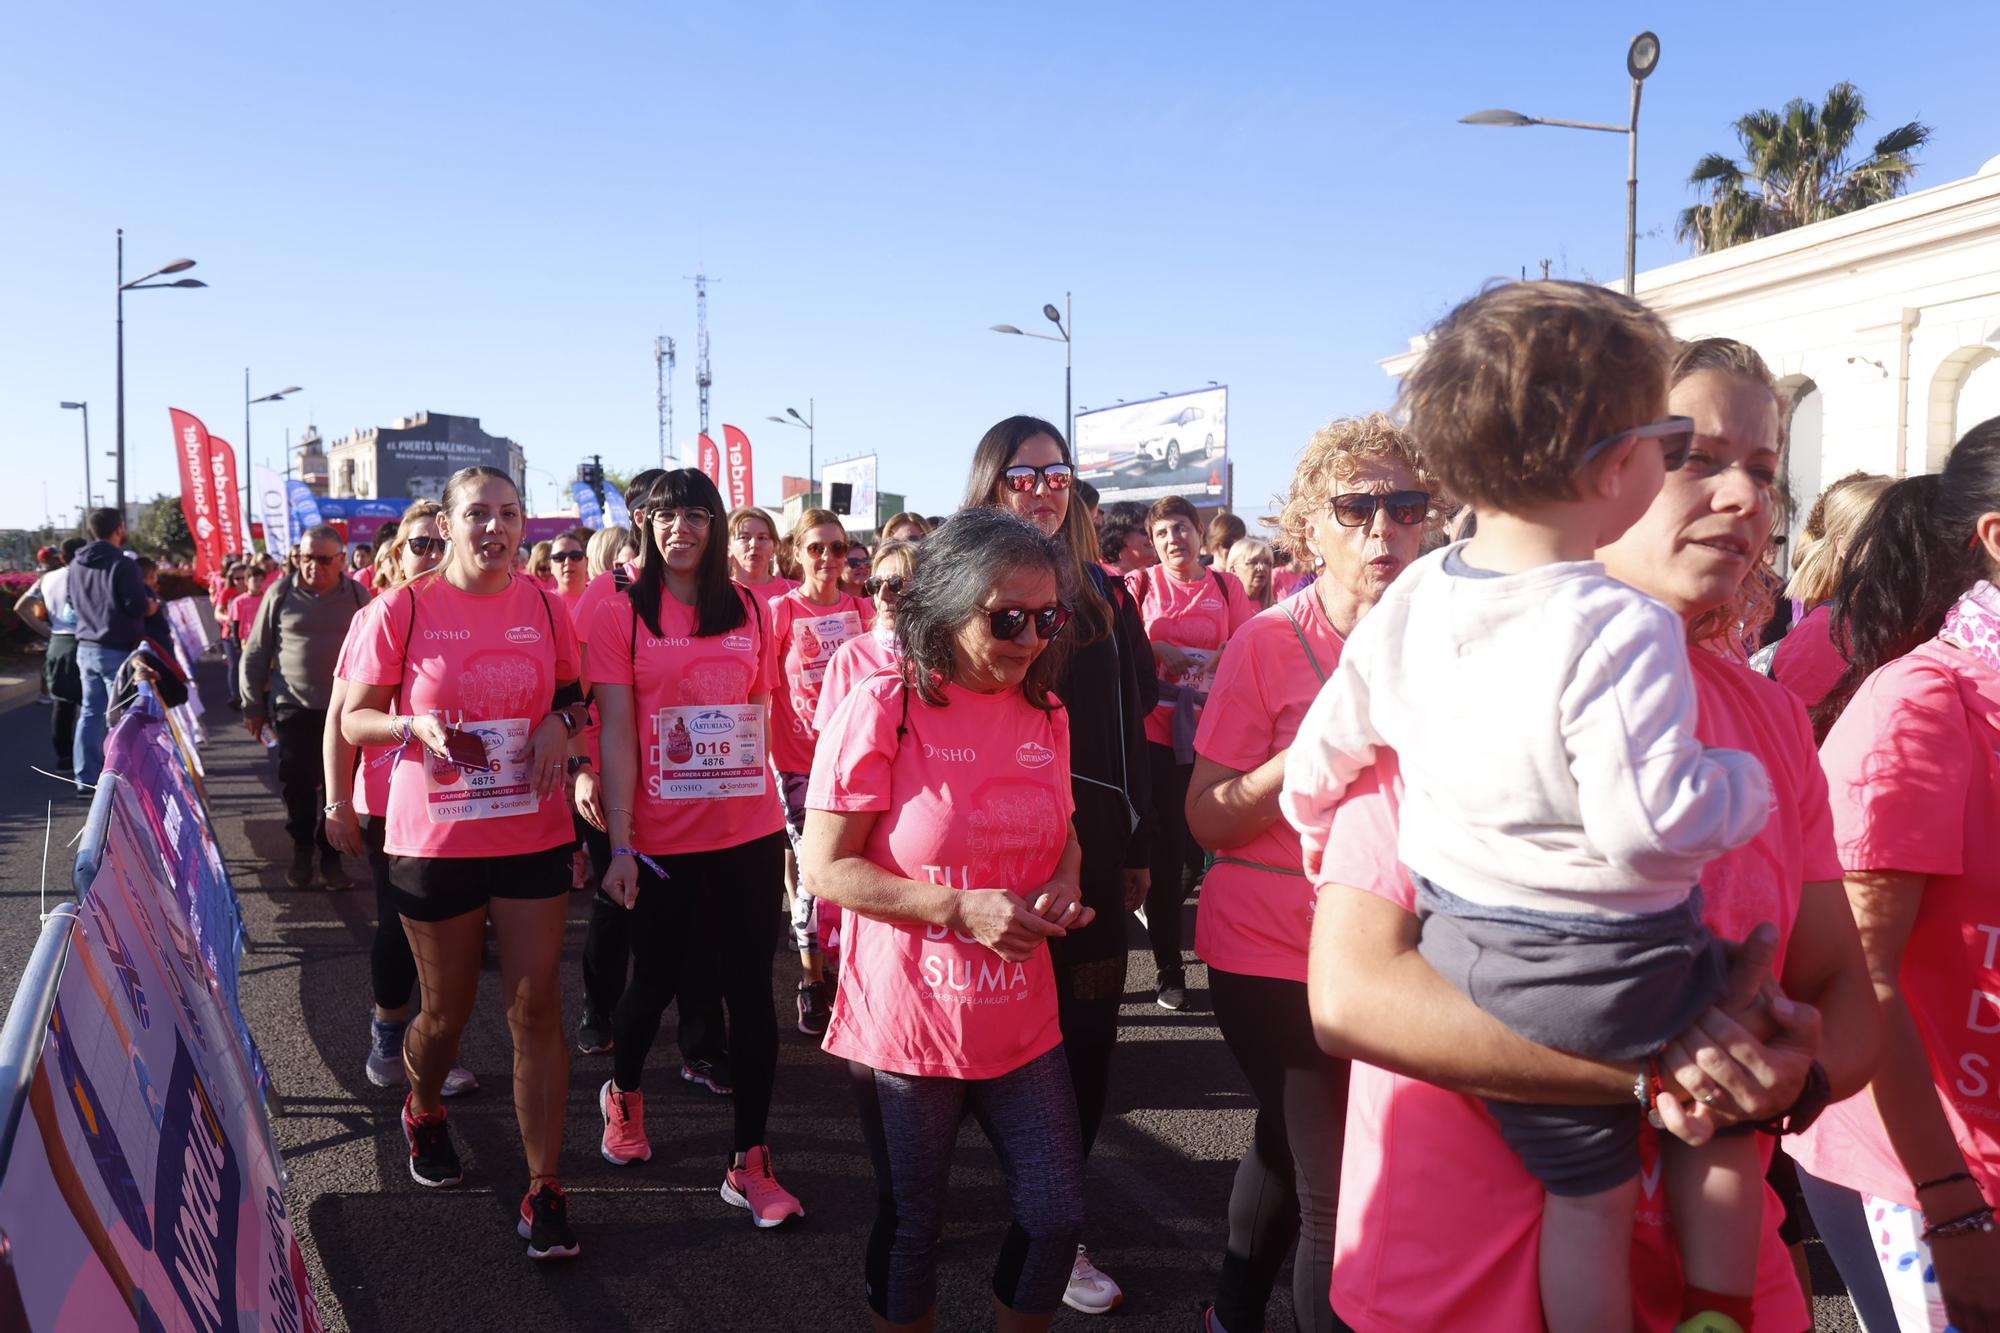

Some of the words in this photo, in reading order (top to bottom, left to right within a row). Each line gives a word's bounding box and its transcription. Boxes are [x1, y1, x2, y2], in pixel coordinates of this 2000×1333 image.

[424, 629, 471, 640] OYSHO
[647, 637, 690, 648] OYSHO
[694, 721, 732, 730] ASTURIANA
[695, 742, 731, 755] 016
[702, 758, 725, 766] 4876
[471, 776, 496, 786] 4875
[670, 784, 702, 792] OYSHO
[440, 792, 471, 800] CARRERA
[438, 805, 473, 815] OYSHO
[923, 954, 1027, 992] SUMA
